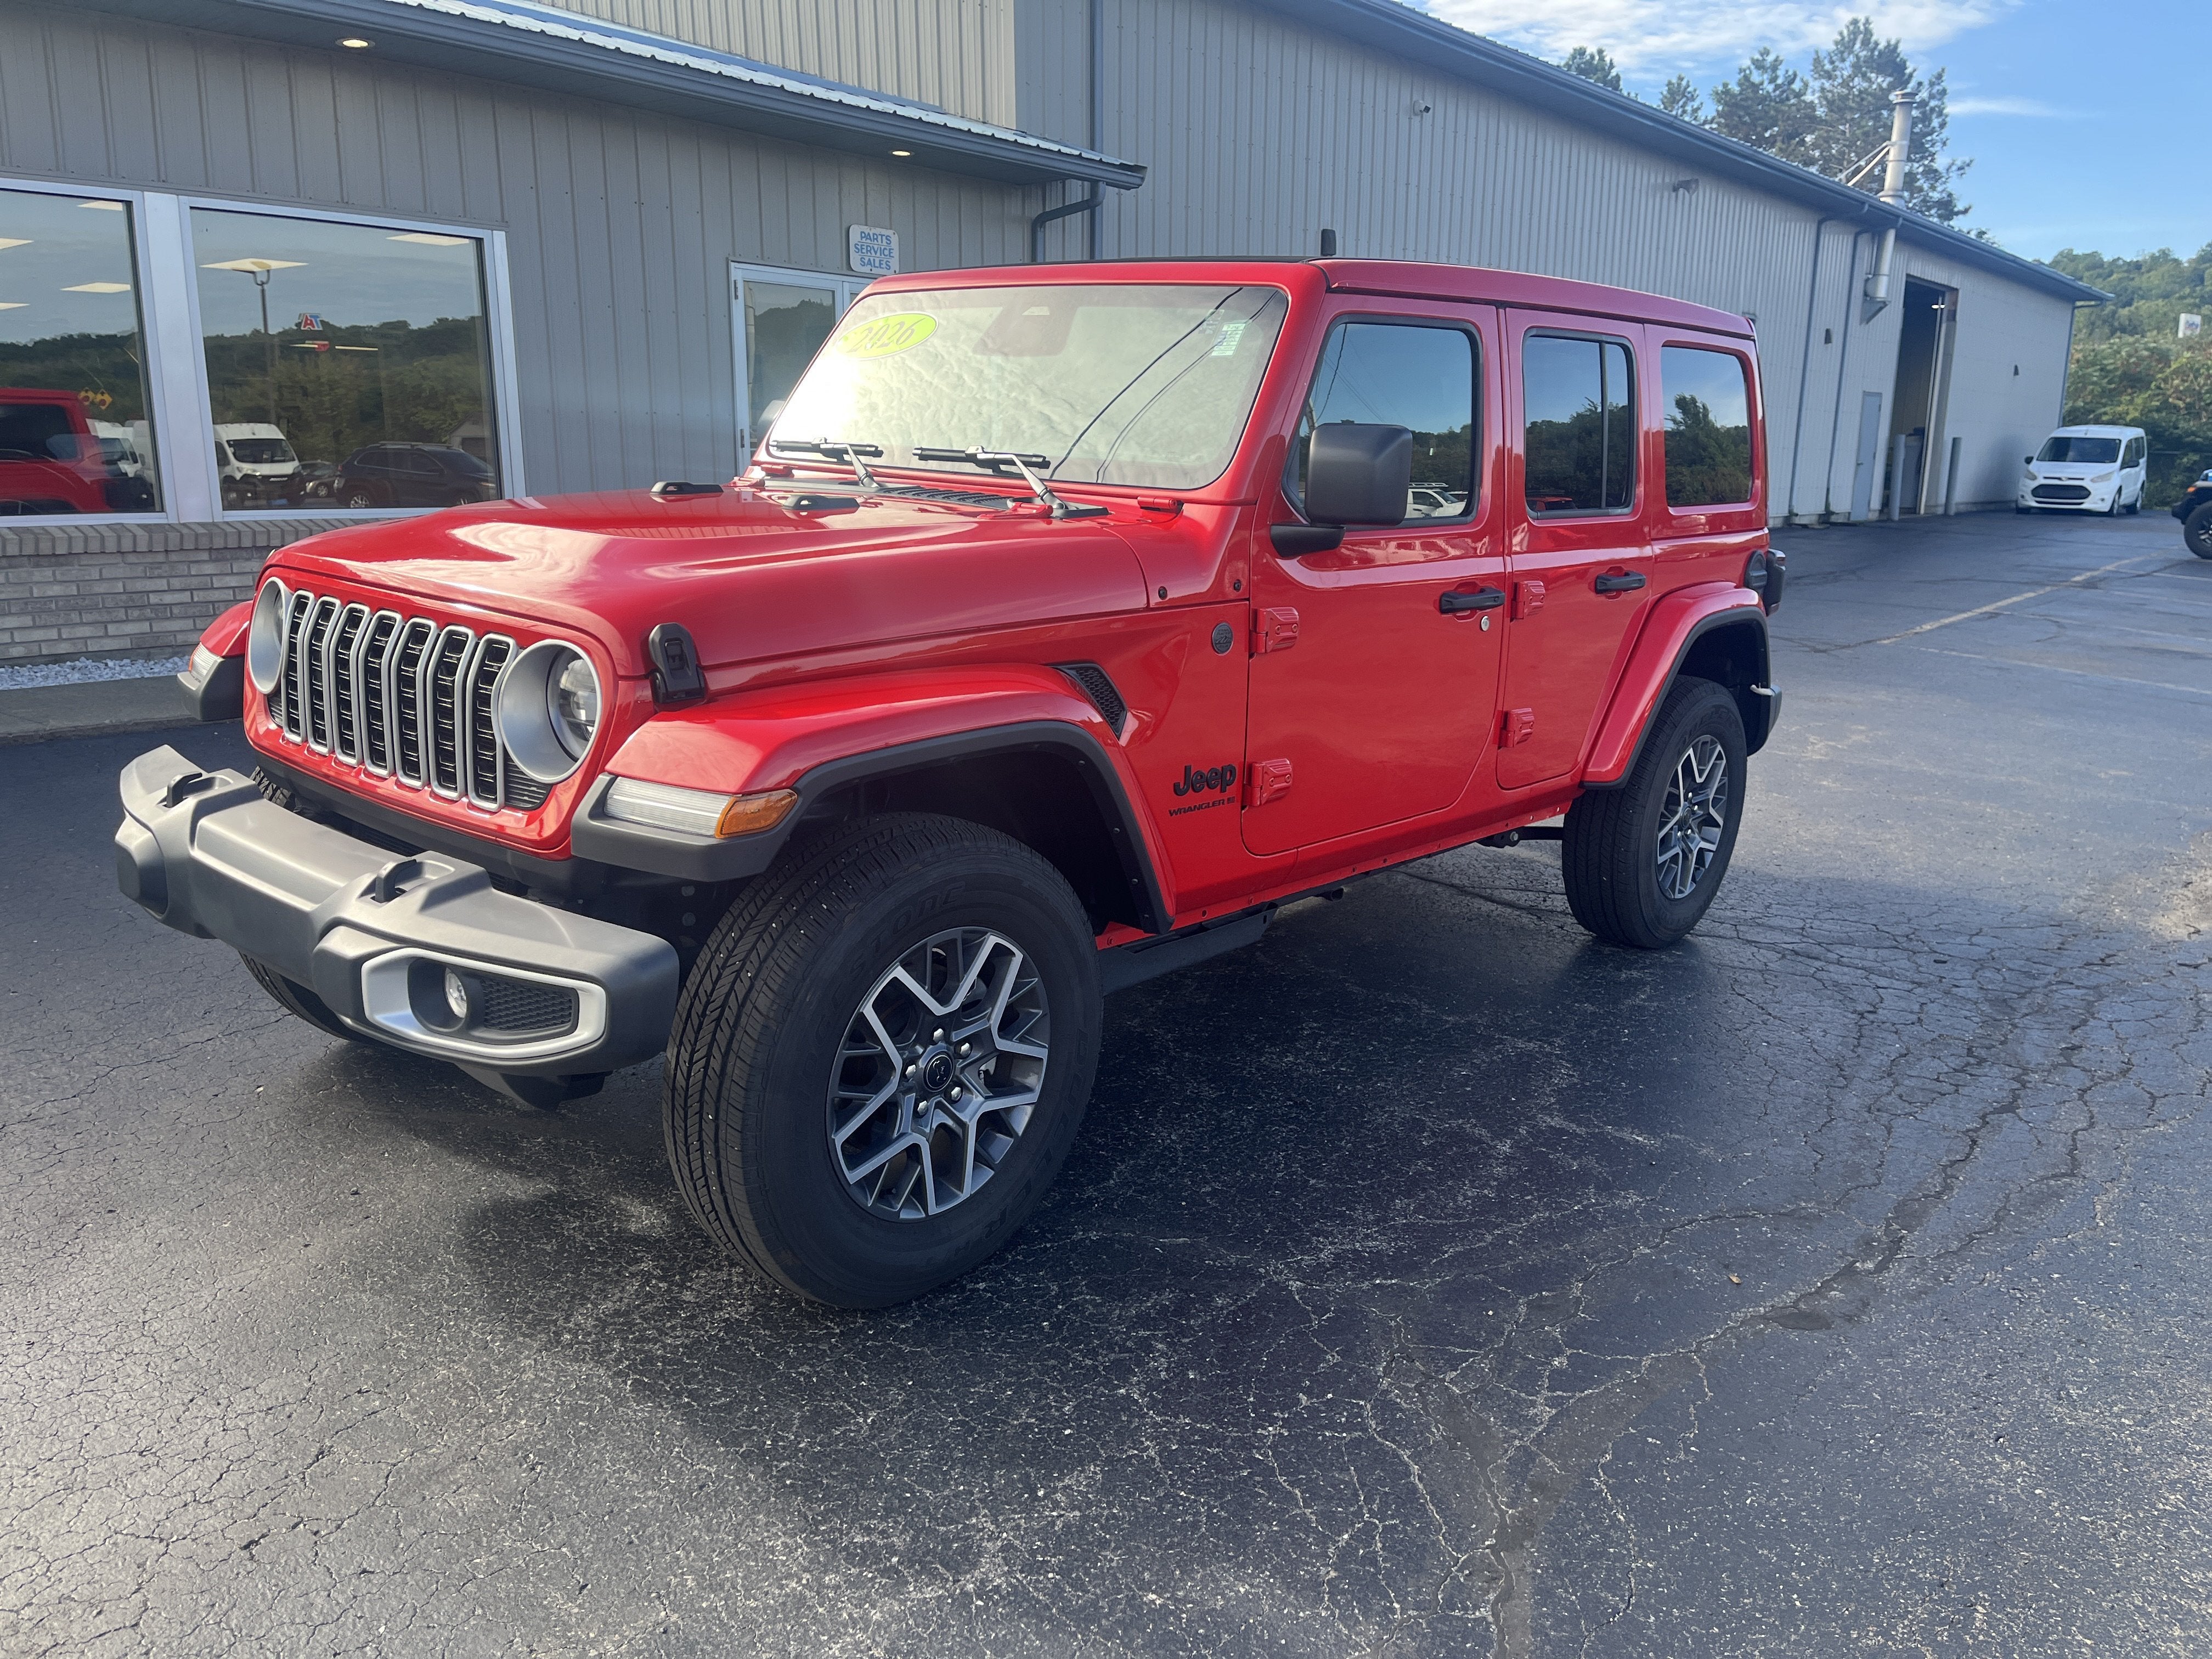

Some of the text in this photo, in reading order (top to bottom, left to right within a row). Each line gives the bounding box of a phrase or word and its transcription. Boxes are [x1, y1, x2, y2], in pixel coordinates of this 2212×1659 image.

[860, 231, 891, 245] PARTS
[854, 243, 894, 258] SERVICE
[860, 257, 891, 270] SALES
[847, 317, 926, 353] 2026
[1173, 764, 1237, 796] Jeep
[1168, 798, 1226, 817] WRANGLER
